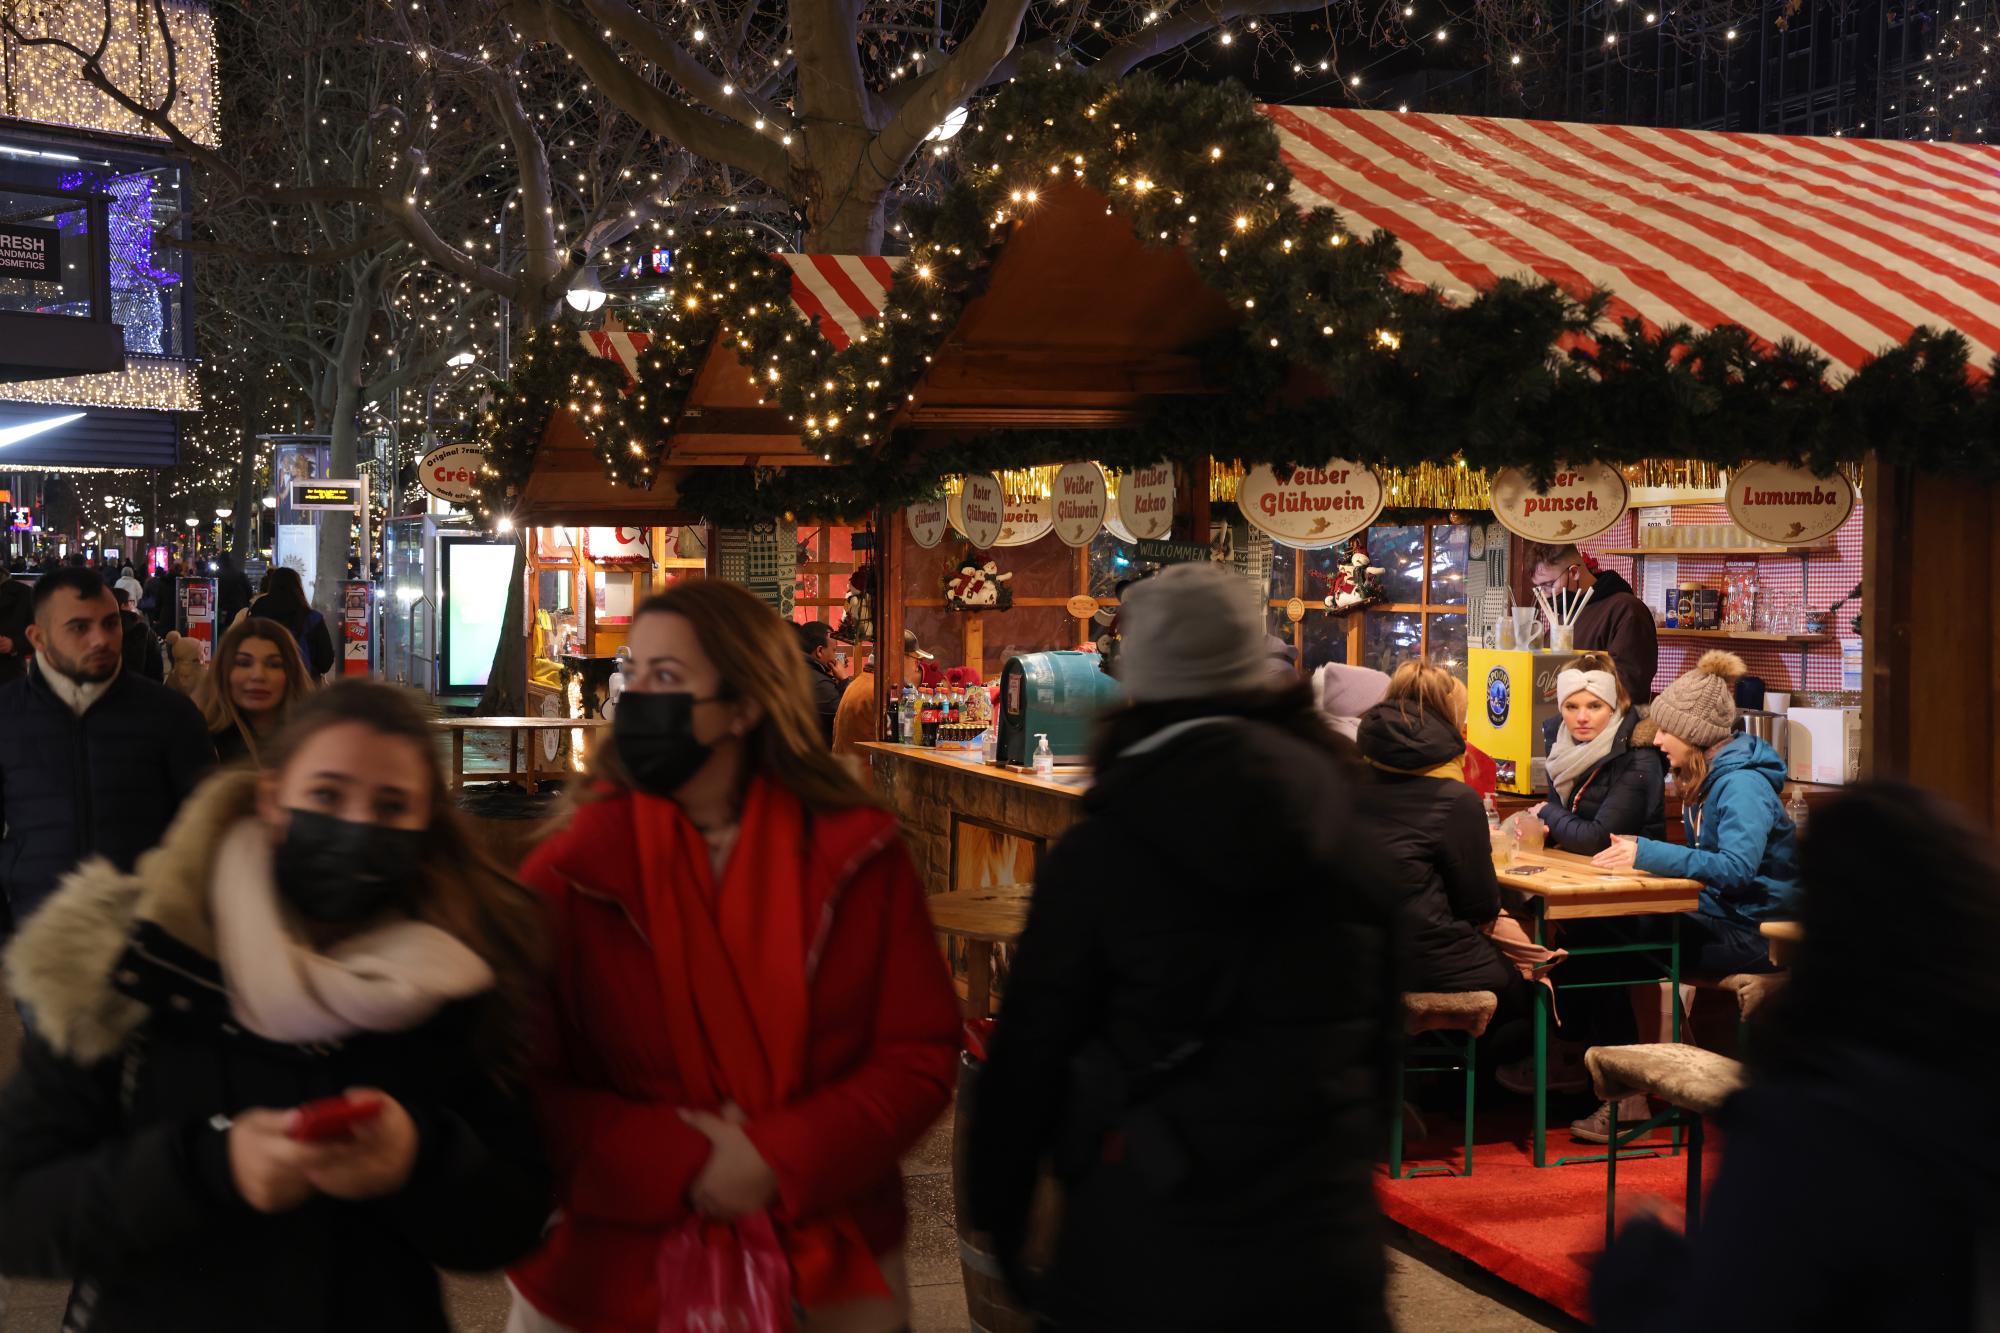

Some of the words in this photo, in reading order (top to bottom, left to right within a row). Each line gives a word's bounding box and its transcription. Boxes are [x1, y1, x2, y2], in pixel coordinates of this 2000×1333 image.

[0, 234, 45, 251] RESH
[0, 249, 45, 261] ANDMADE
[0, 258, 45, 270] OSMETICS
[972, 483, 992, 500] Roter
[1063, 476, 1095, 495] Weißer
[1743, 485, 1837, 505] Lumumba
[1057, 500, 1099, 524] Glühwein
[1134, 493, 1167, 515] Kakao
[1259, 489, 1366, 517] Glühwein
[1523, 491, 1599, 518] punsch
[966, 503, 998, 525] Glühwein
[1139, 542, 1207, 562] WILLKOMMEN
